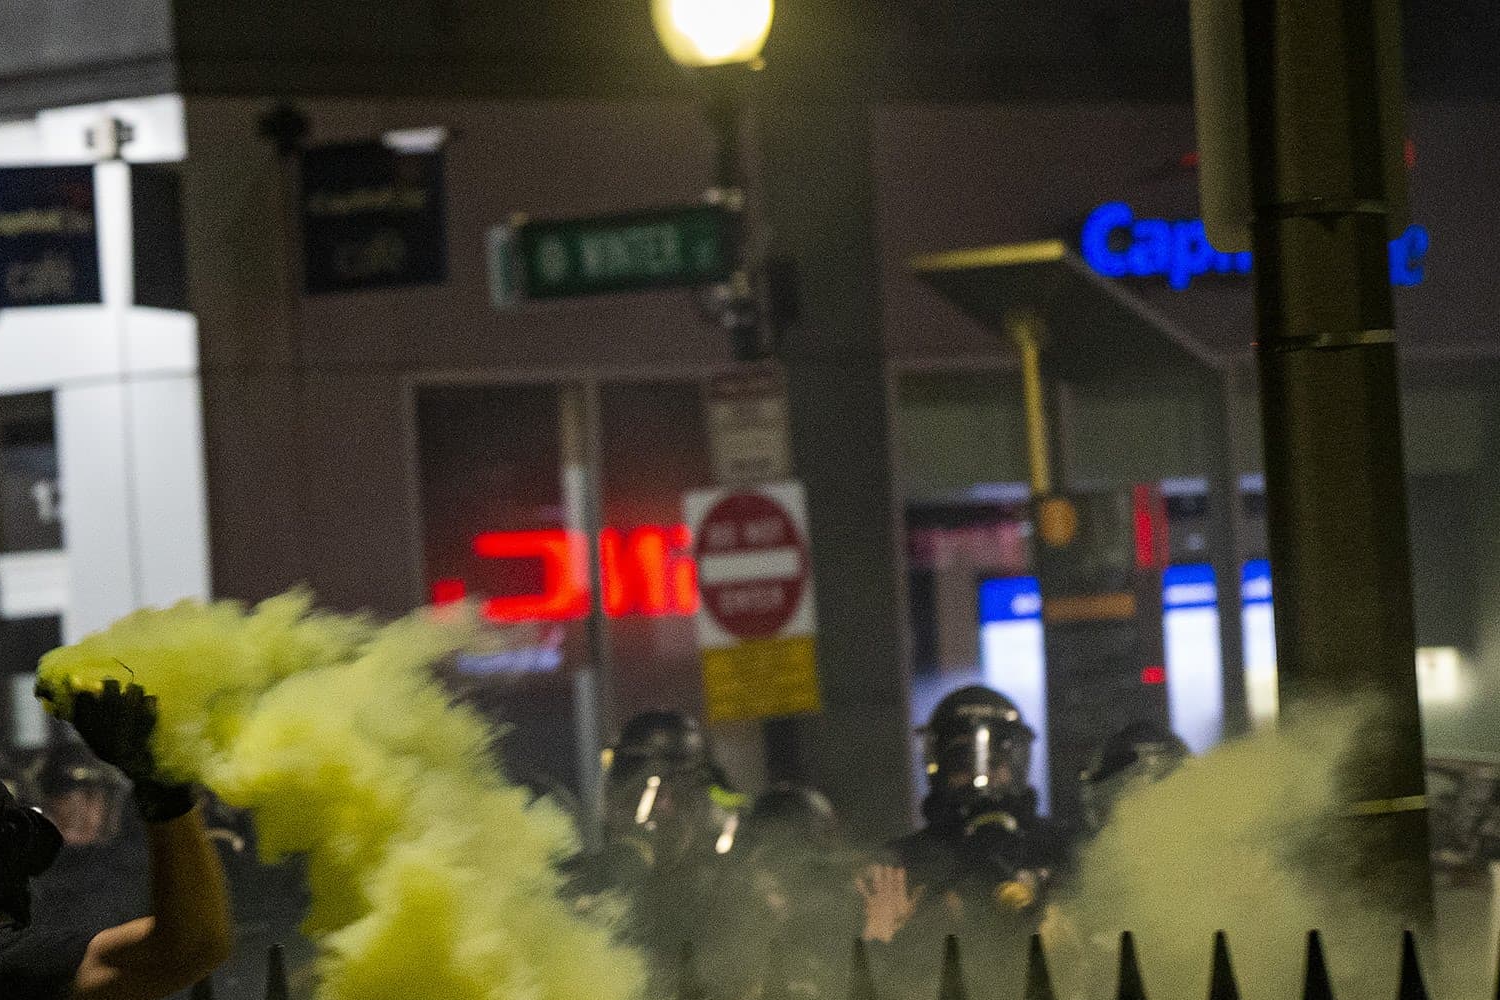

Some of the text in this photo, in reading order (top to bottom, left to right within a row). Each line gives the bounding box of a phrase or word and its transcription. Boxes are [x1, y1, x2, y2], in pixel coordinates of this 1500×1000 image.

[707, 517, 784, 547] DO NOT
[718, 586, 784, 615] ENTER
